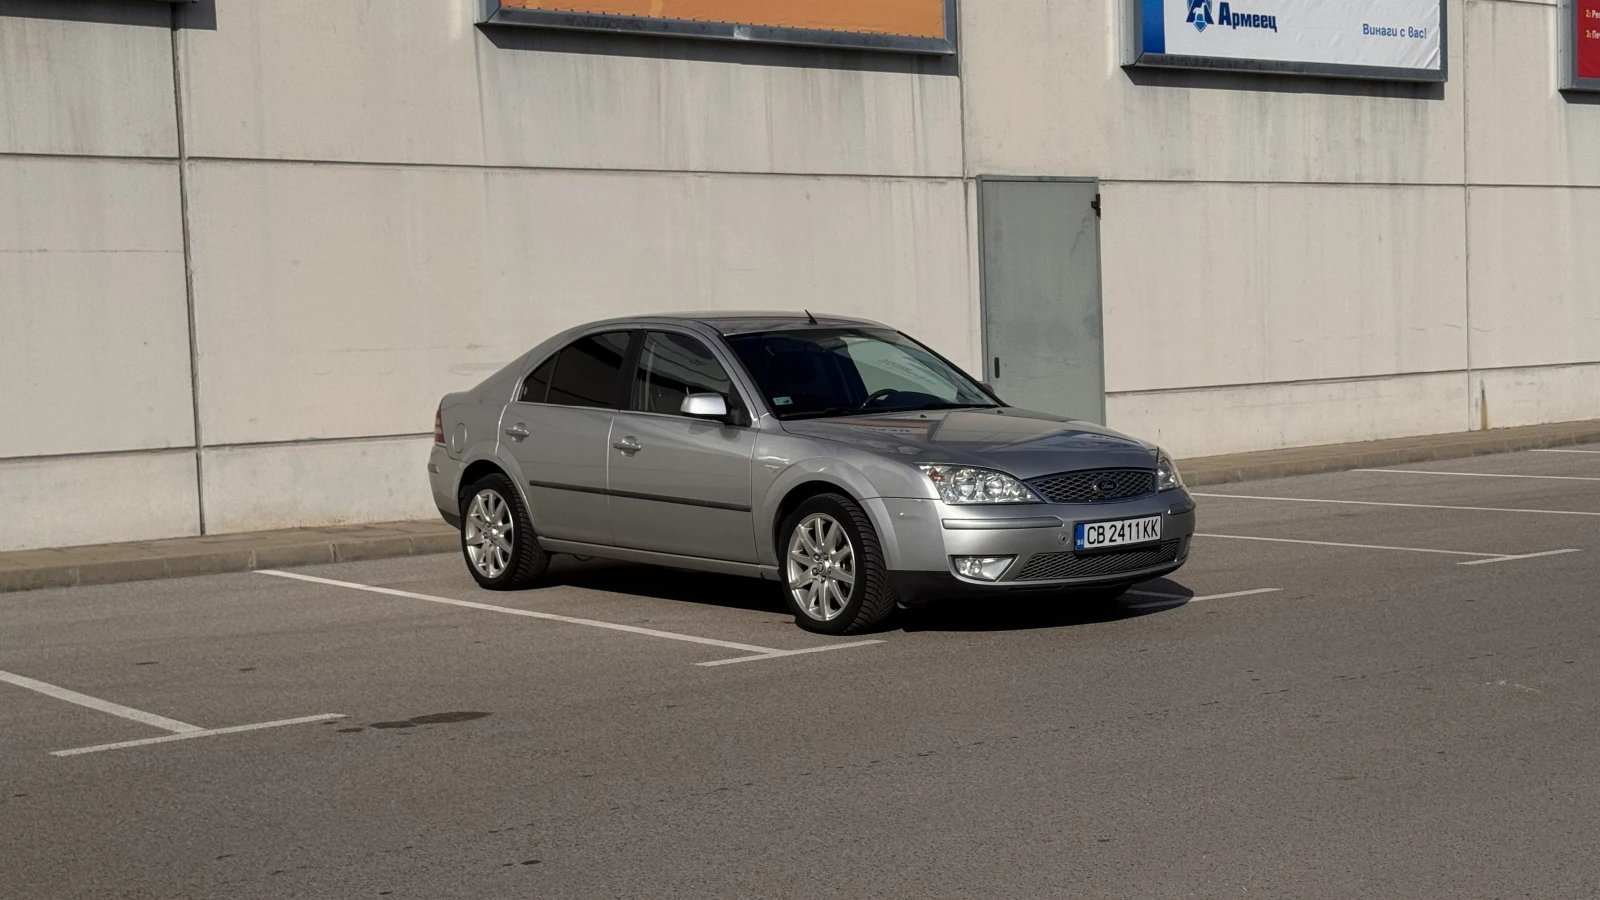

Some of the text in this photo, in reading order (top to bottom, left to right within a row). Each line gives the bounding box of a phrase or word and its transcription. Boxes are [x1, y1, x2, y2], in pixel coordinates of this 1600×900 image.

[1218, 1, 1278, 33] Армеец
[1362, 23, 1398, 37] Винаги
[1399, 28, 1406, 37] с
[1087, 518, 1159, 544] CB 2411 KK
